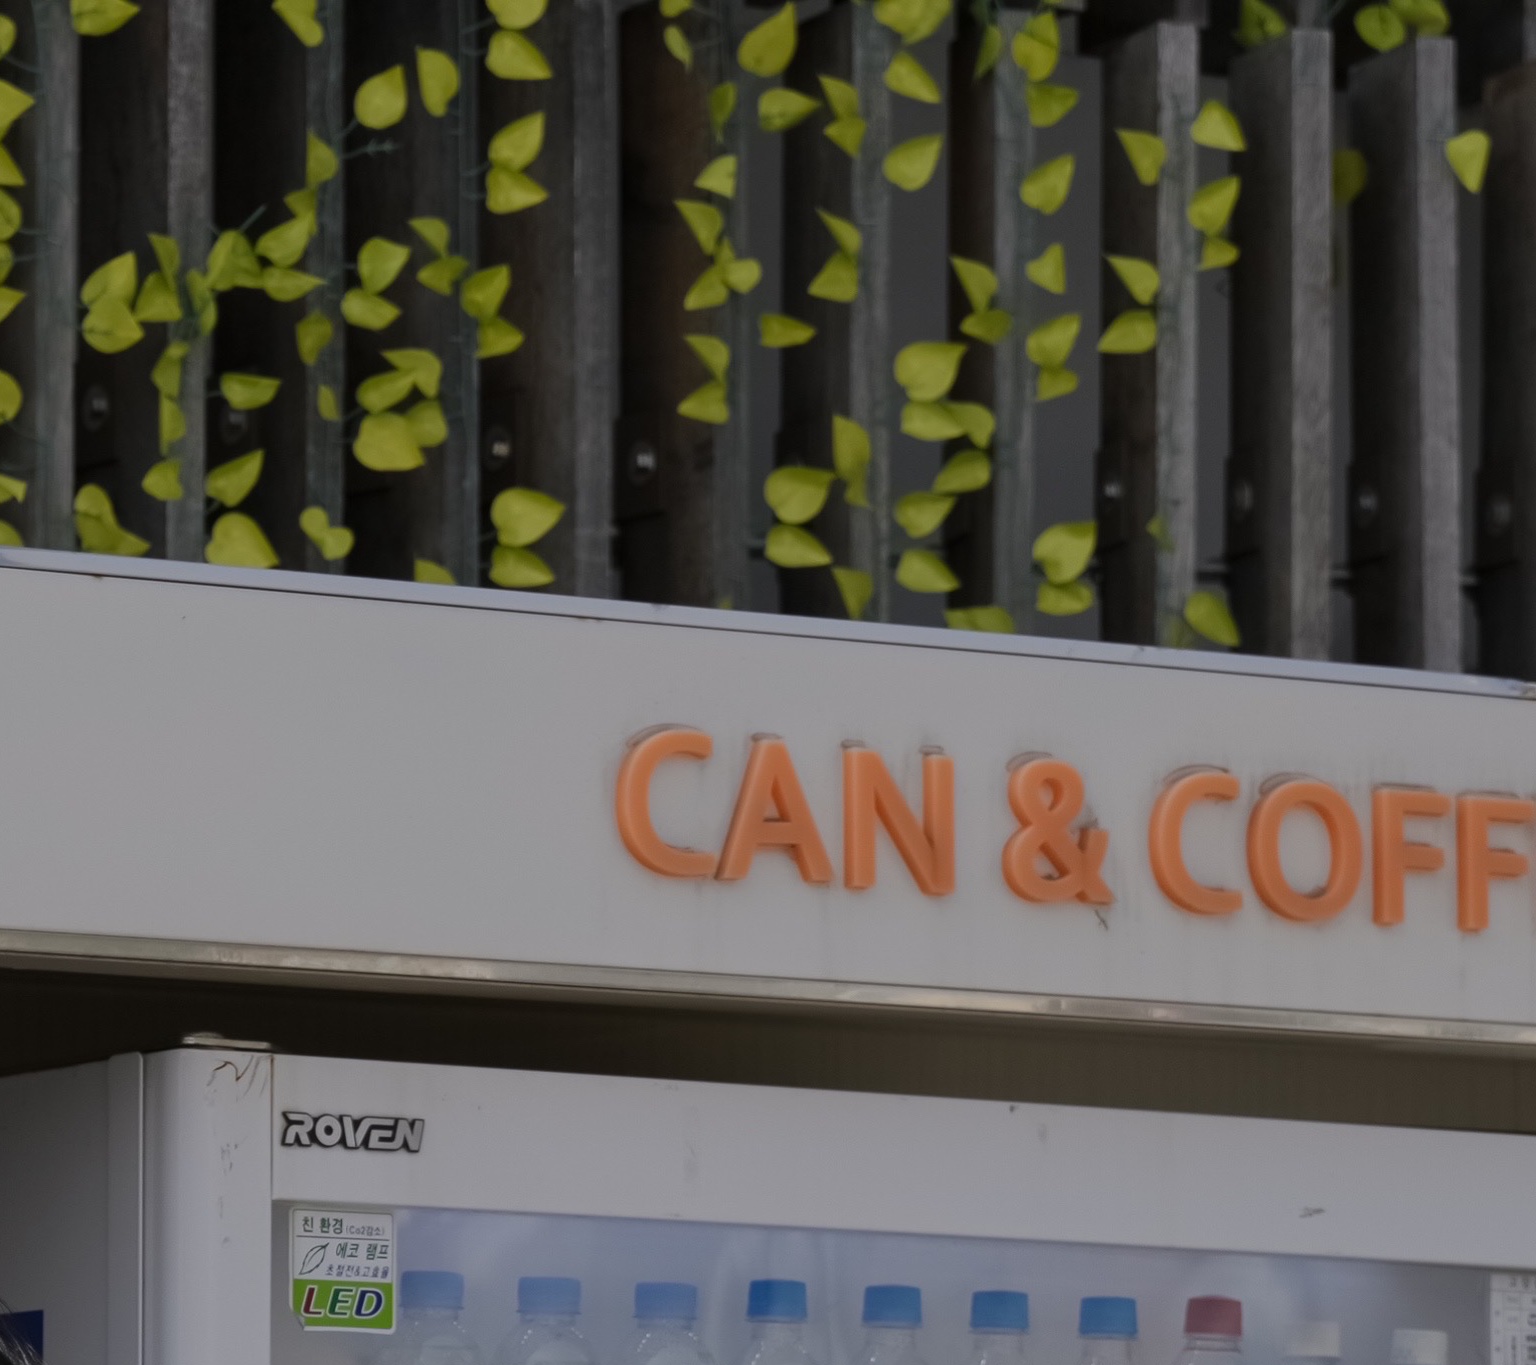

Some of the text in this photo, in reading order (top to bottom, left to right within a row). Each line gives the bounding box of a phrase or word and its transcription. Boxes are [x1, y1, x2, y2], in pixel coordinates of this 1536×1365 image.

[614, 727, 956, 896] CAN
[1001, 752, 1115, 906] &
[281, 1111, 424, 1153] ROVEN
[302, 1216, 313, 1233] 친
[320, 1216, 343, 1234] 환경
[335, 1242, 389, 1260] 에코 램프
[302, 1285, 384, 1318] LED
